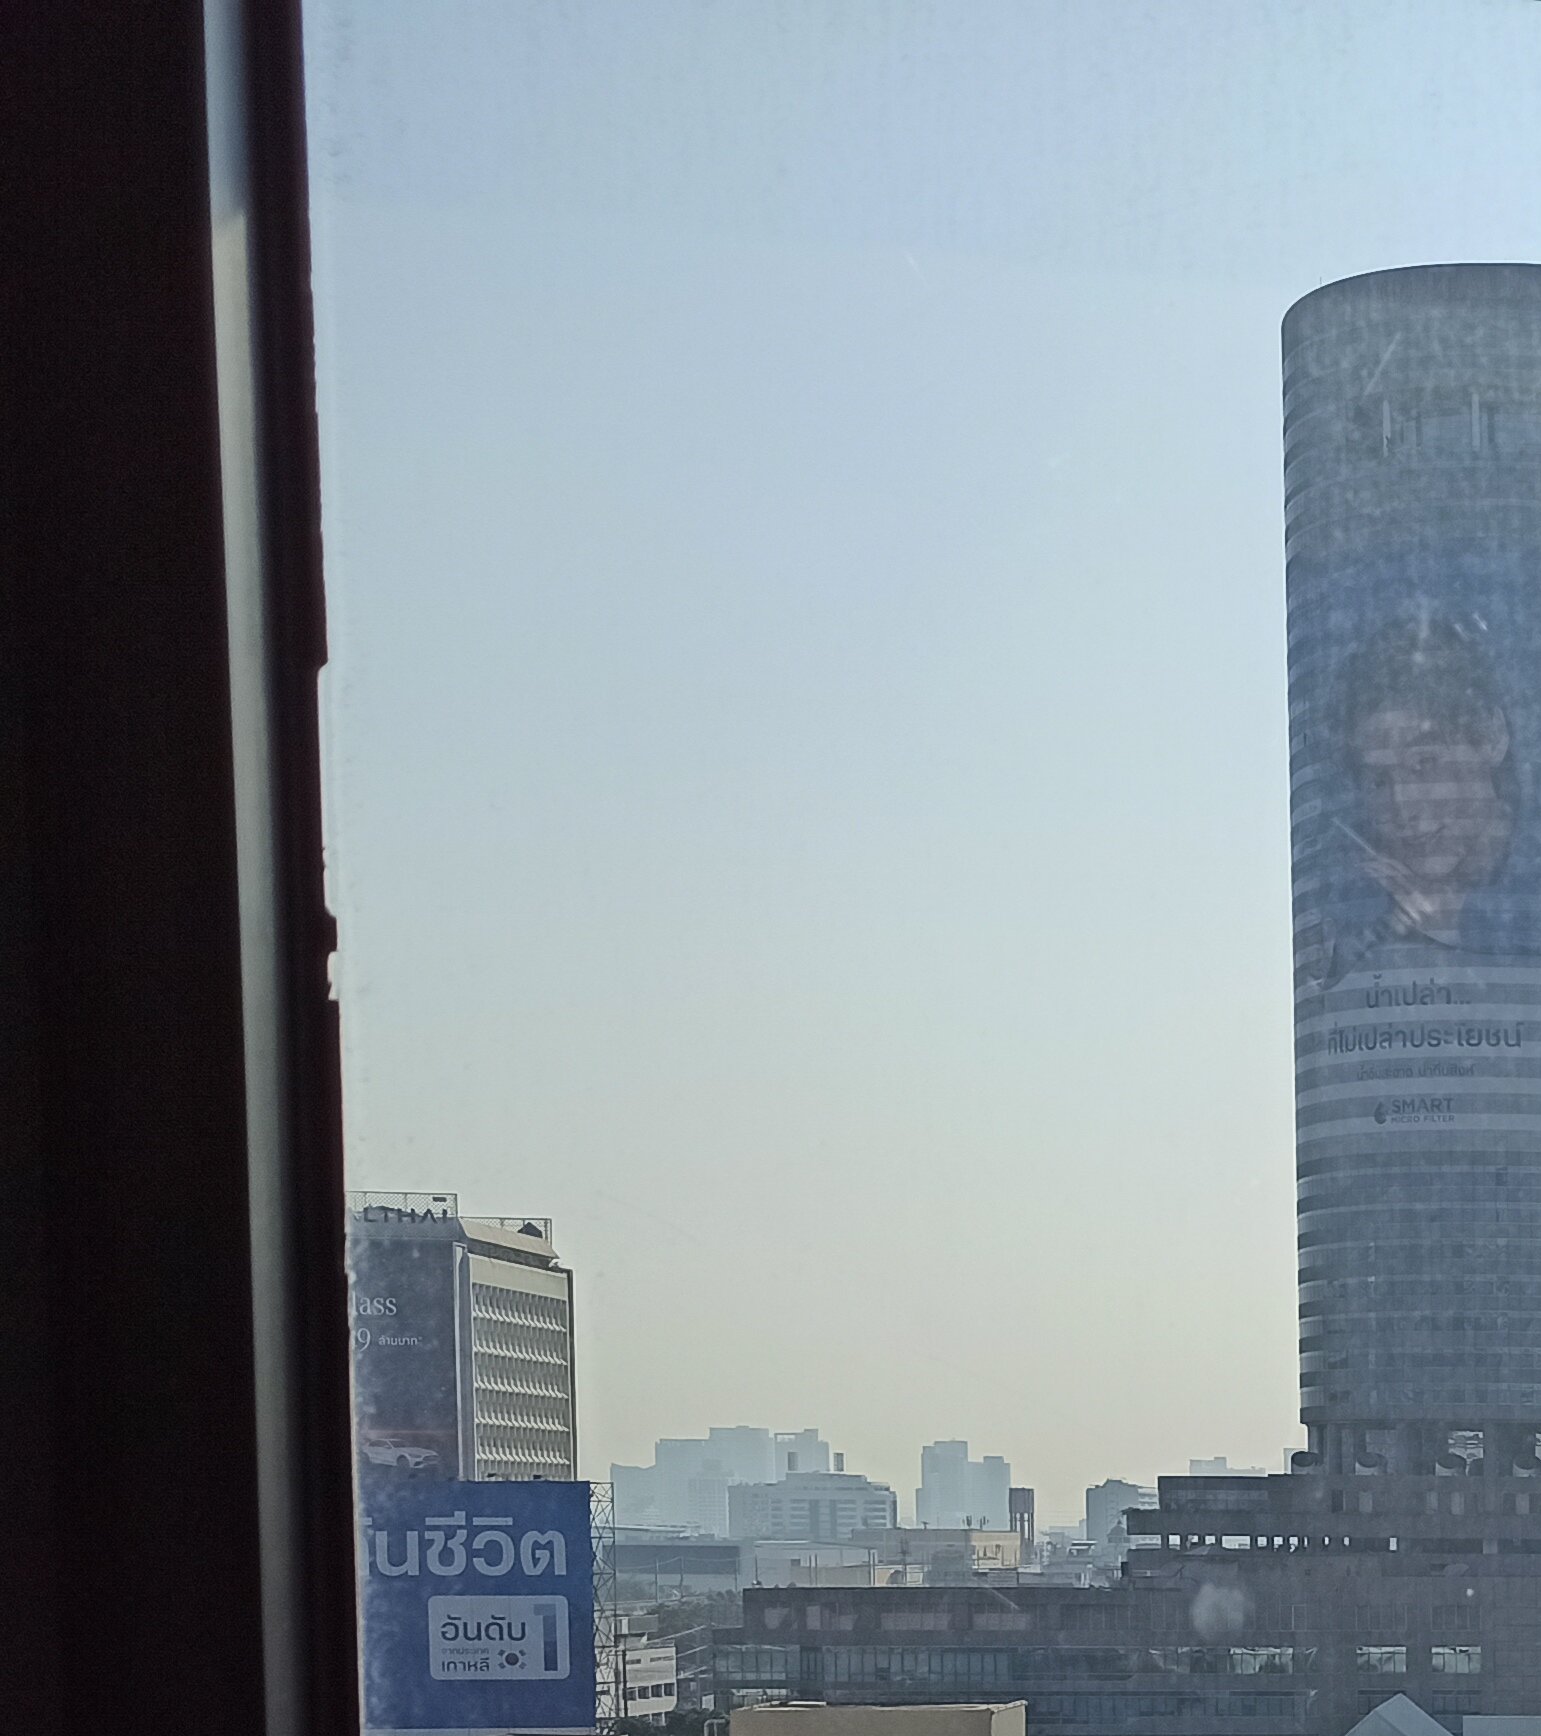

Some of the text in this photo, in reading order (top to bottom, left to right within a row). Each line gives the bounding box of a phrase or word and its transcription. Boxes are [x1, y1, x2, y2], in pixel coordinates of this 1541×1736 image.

[1327, 1022, 1525, 1054] ที่ไม่เปล่าประโยชน์
[1392, 1098, 1455, 1114] SMART
[1424, 1114, 1456, 1123] FILTER
[440, 1613, 527, 1642] อันดับ
[441, 1657, 490, 1673] เกาหลี
